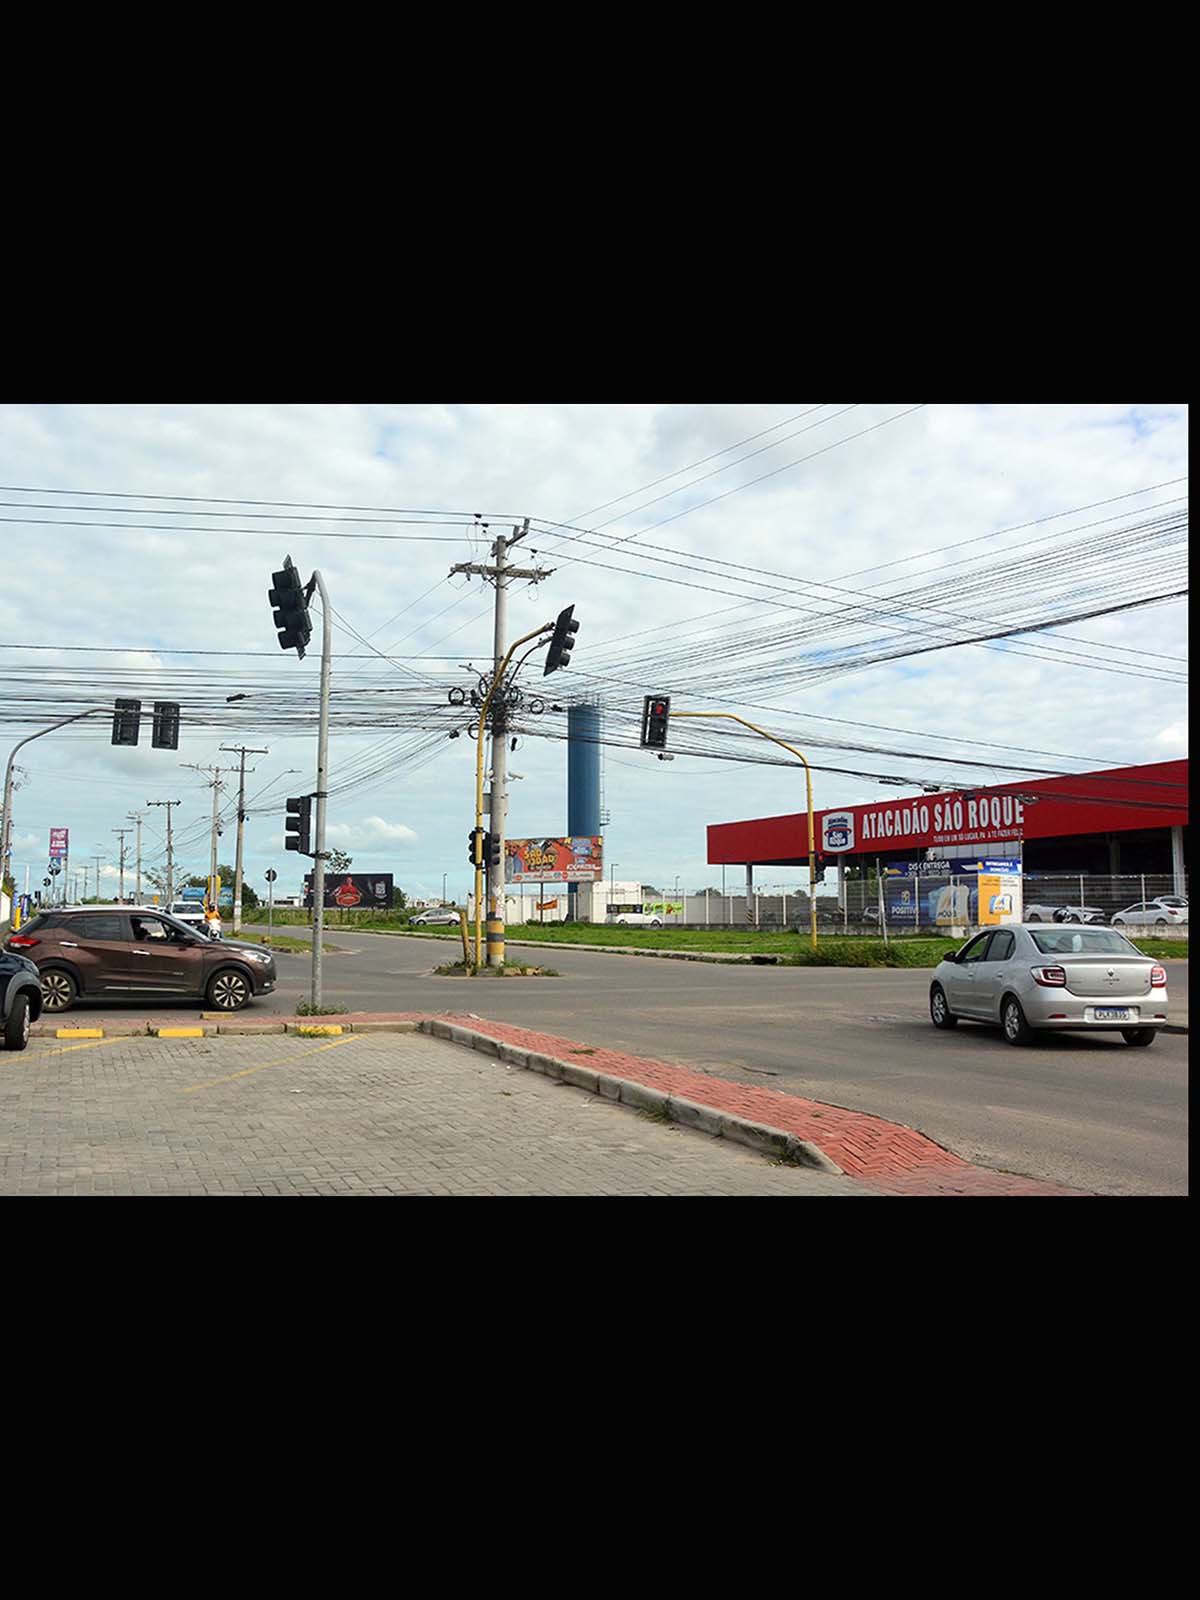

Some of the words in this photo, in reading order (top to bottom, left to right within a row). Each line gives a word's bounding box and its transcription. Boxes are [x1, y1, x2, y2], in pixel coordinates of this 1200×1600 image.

[862, 800, 929, 839] ATACADÃO
[934, 796, 963, 832] SÃO
[968, 795, 1025, 829] ROQUE
